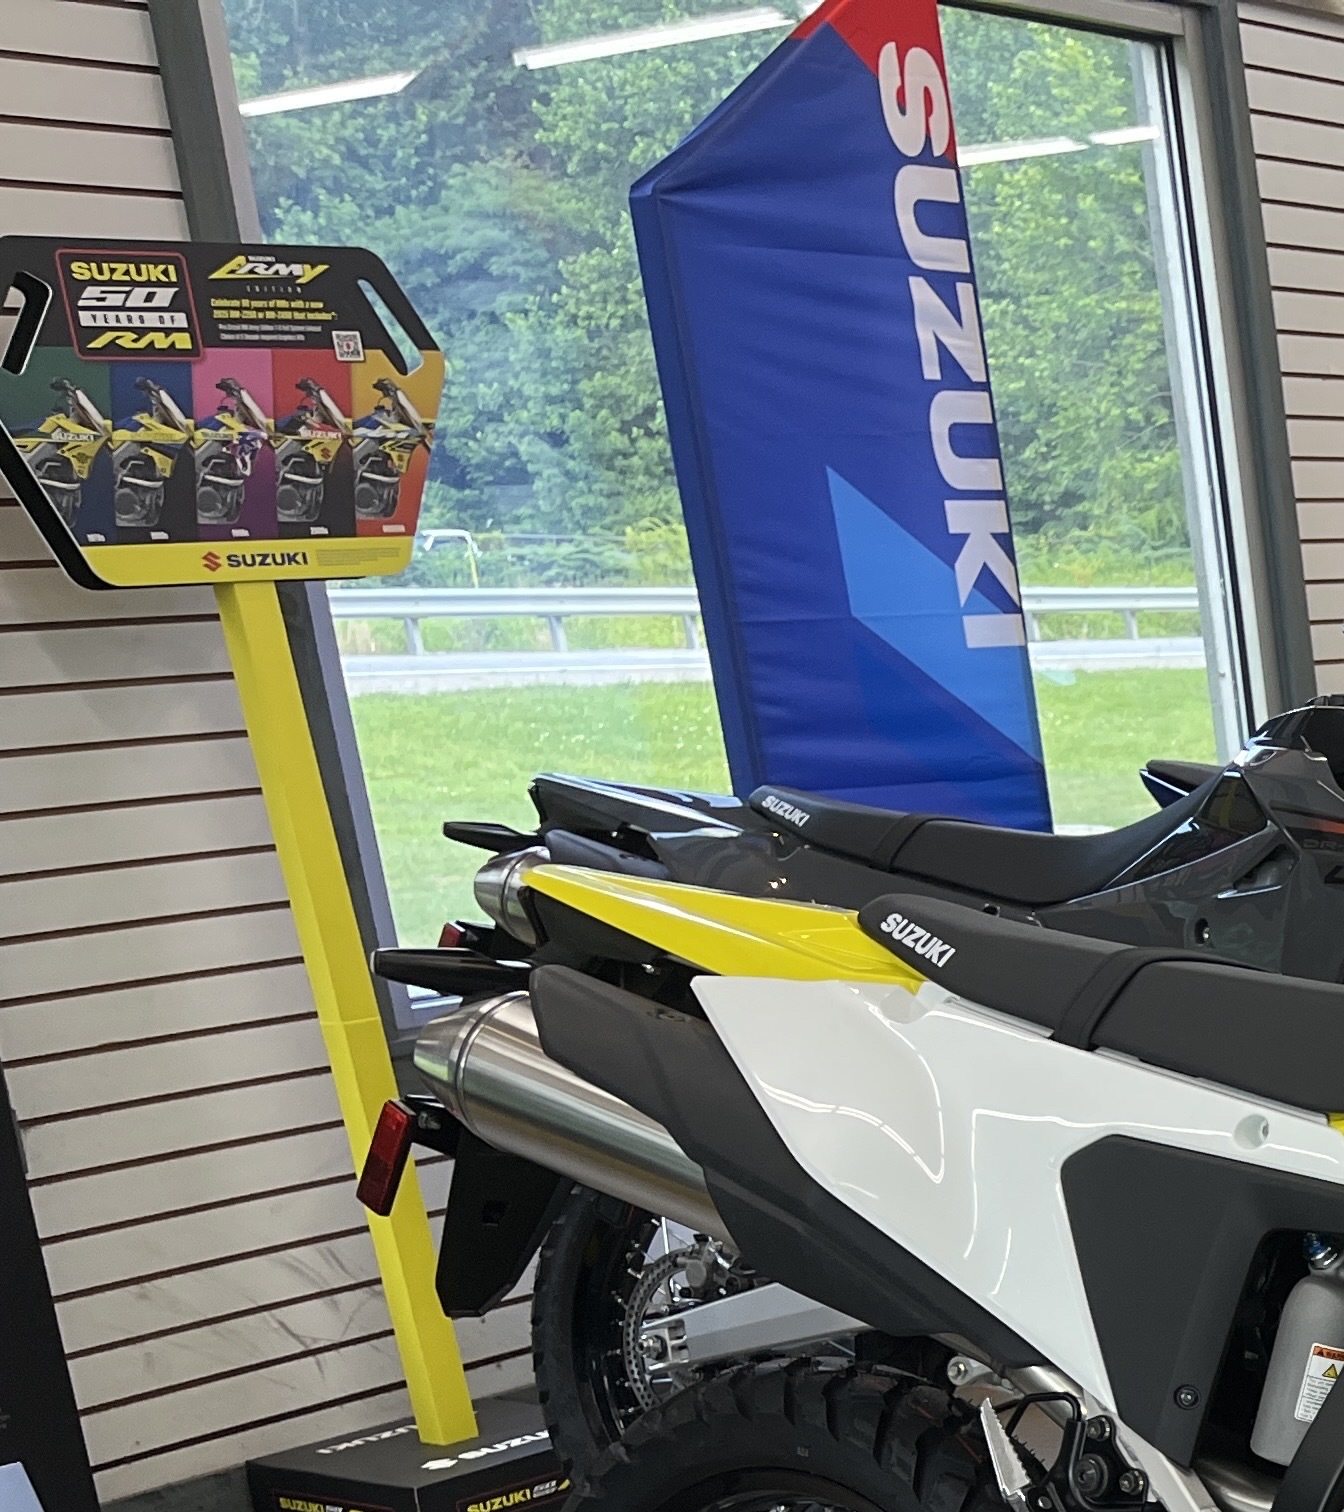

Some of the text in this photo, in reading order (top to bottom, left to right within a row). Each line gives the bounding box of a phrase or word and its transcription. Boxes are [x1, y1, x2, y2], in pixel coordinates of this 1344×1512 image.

[70, 261, 178, 282] SUZUKI
[77, 285, 180, 308] 50
[90, 313, 176, 326] YEARS OF
[86, 331, 193, 350] RM
[879, 41, 1026, 649] SUZUKI
[226, 551, 308, 568] SUZUKI
[761, 795, 810, 828] SUZUKI
[880, 913, 956, 968] SUZUKI
